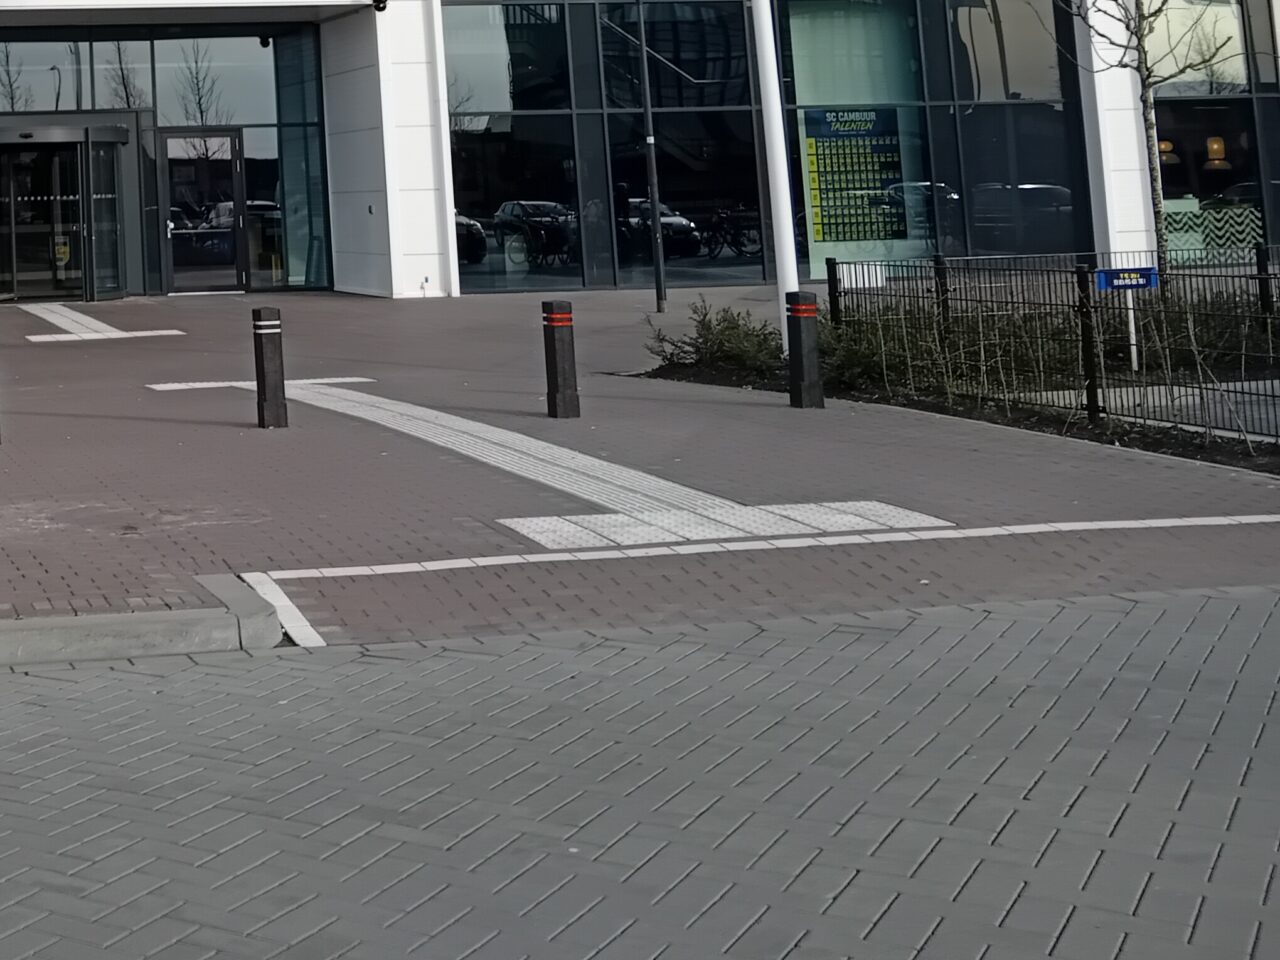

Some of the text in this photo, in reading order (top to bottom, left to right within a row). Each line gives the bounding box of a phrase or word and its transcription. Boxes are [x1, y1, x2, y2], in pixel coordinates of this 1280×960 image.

[825, 111, 876, 122] SC CAMBUUR
[830, 121, 874, 131] TALENTEN
